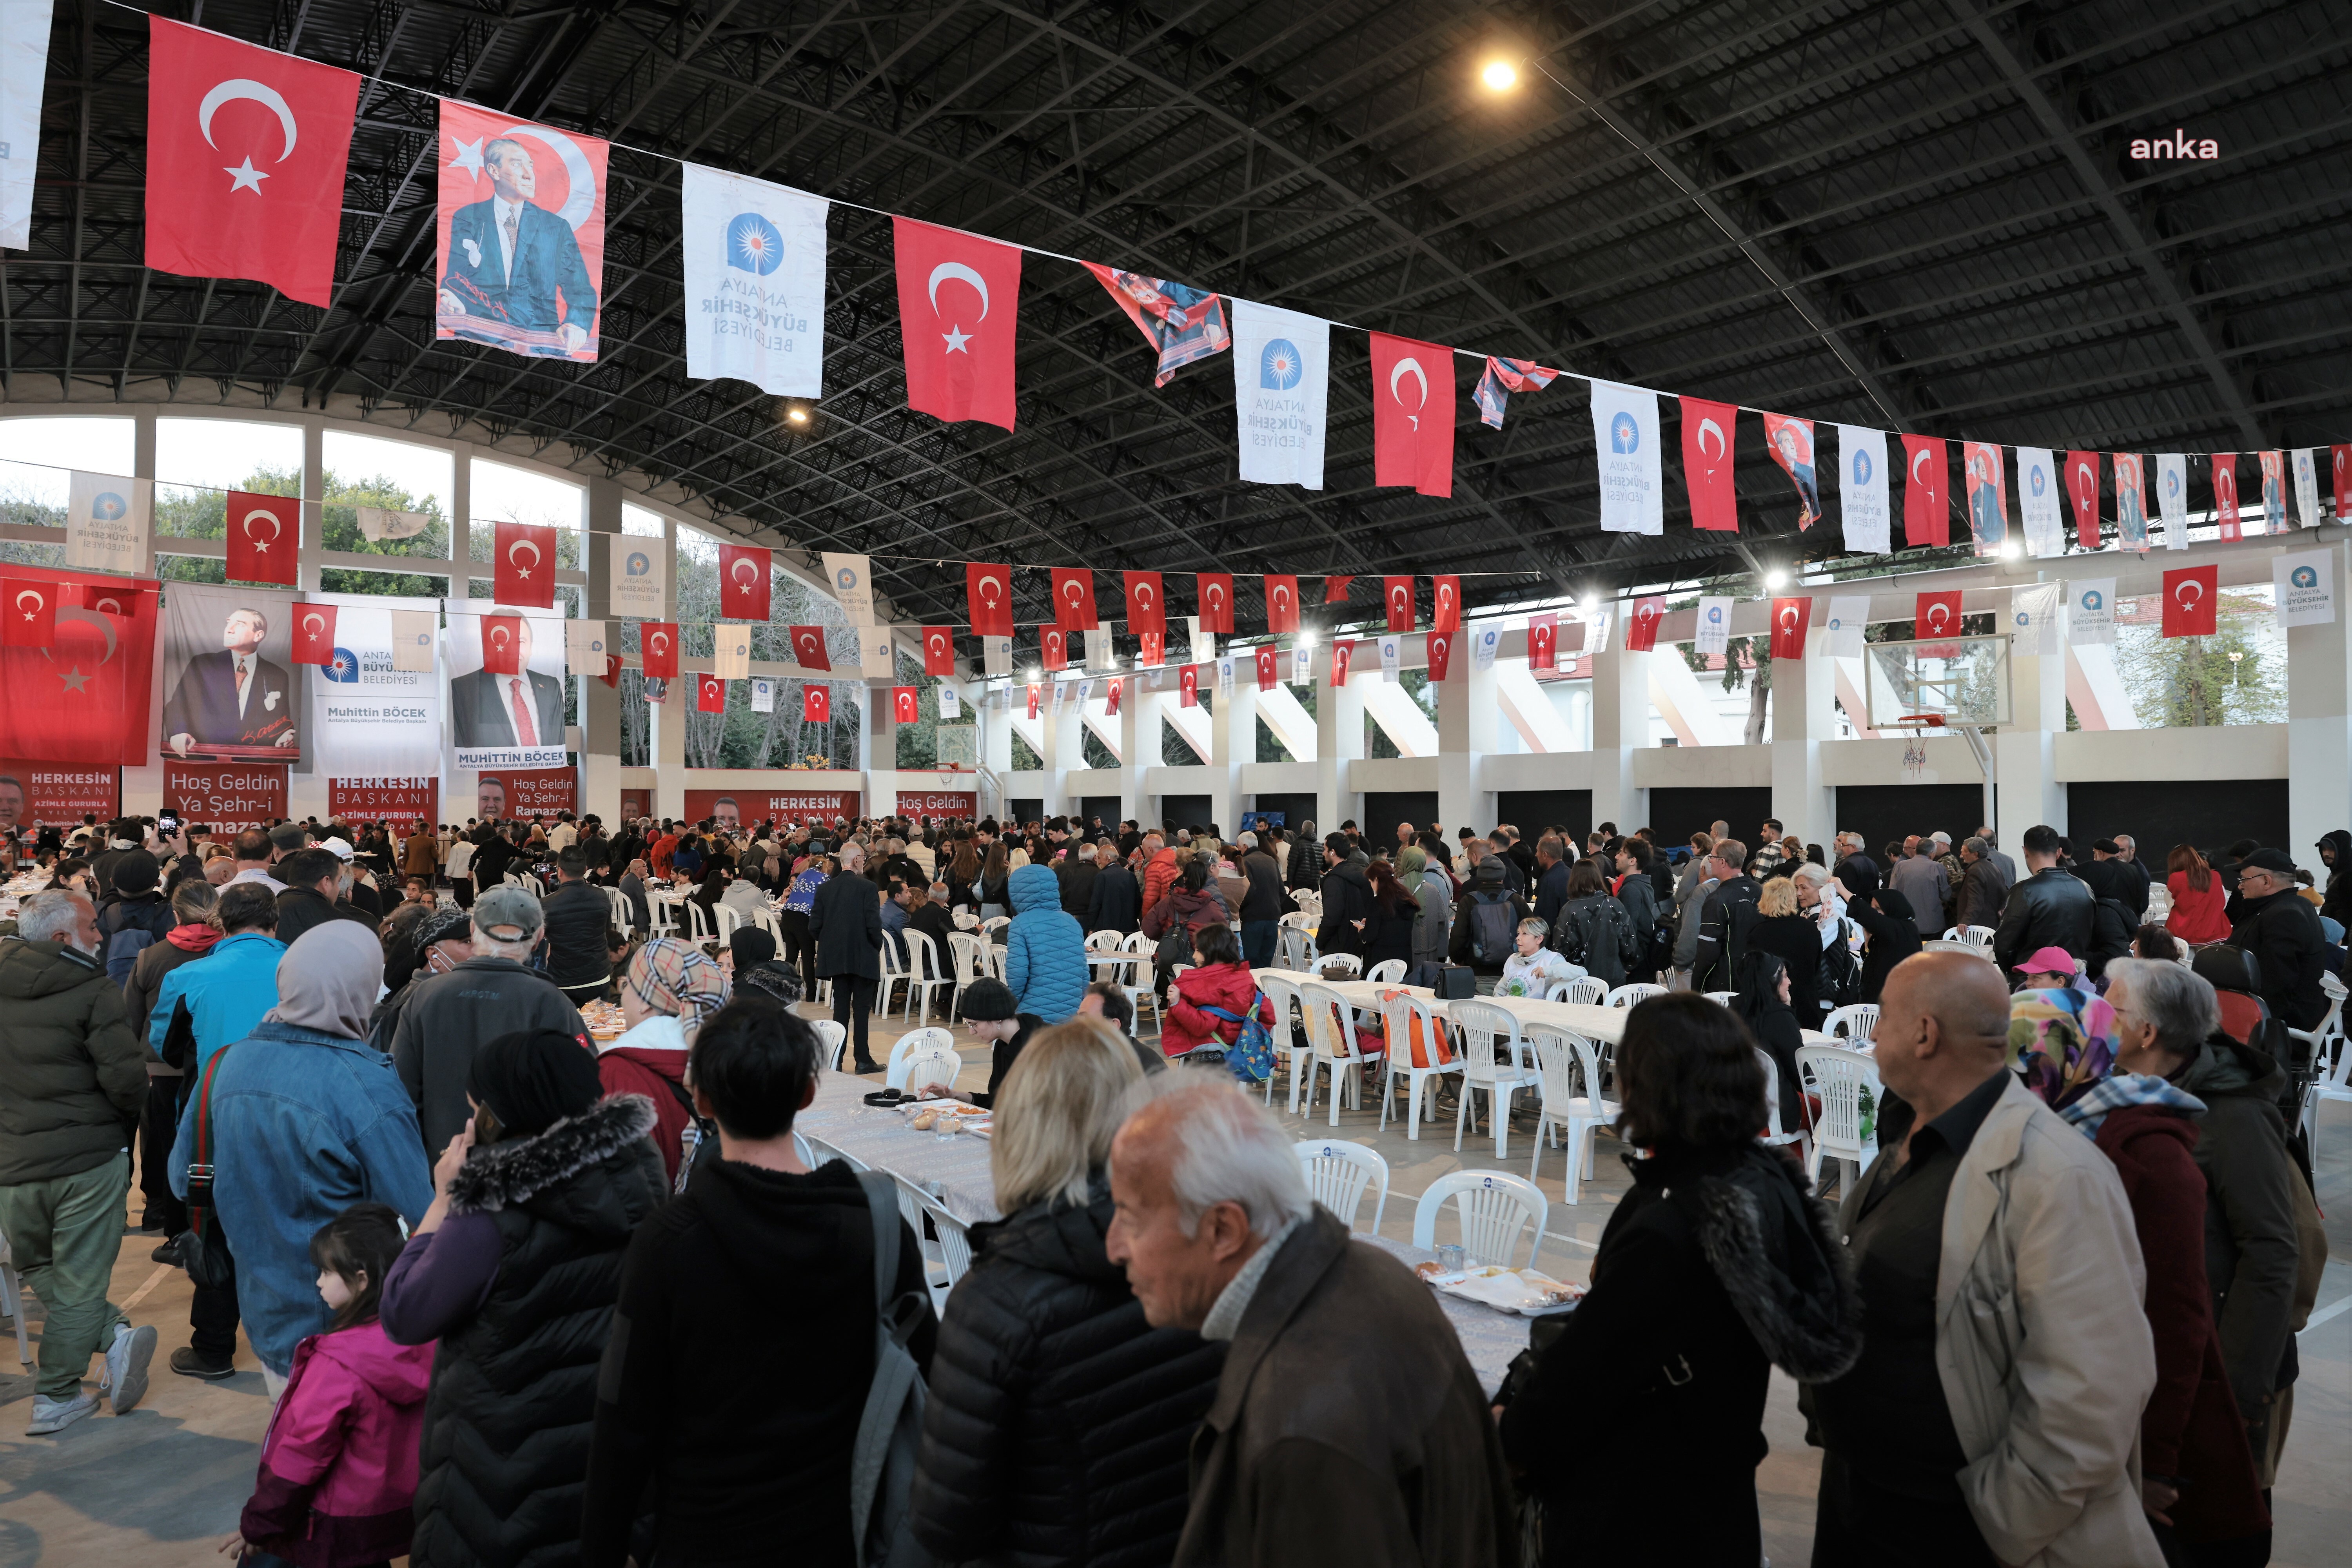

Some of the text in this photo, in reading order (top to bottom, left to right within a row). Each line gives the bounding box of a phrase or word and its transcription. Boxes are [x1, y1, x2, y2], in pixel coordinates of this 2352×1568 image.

[2289, 588, 2321, 597] ANTALYA
[2282, 593, 2329, 605] BÜYÜKŞEHİR
[2288, 602, 2325, 613] BELEDİYESİ
[2073, 617, 2111, 625] BÜYÜKŞEHİR
[363, 674, 417, 685] BELEDİYESİ
[328, 706, 426, 717] Muhittin BÖCEK
[459, 751, 564, 763] MUHİTTİN BÖCEK
[31, 771, 111, 784] HERKESİN
[172, 773, 279, 794] Hoş Geldin
[514, 778, 573, 791] Hoş Geldin
[32, 786, 111, 796] BAŞKANI
[337, 793, 428, 805] BAŞKANI
[517, 792, 569, 805] Ya Şehr-i
[770, 795, 840, 809] HERKESİN
[896, 795, 967, 813] Hoş Geldin
[178, 795, 271, 816] Ya Şehr-i
[341, 810, 376, 819] AZİMLE
